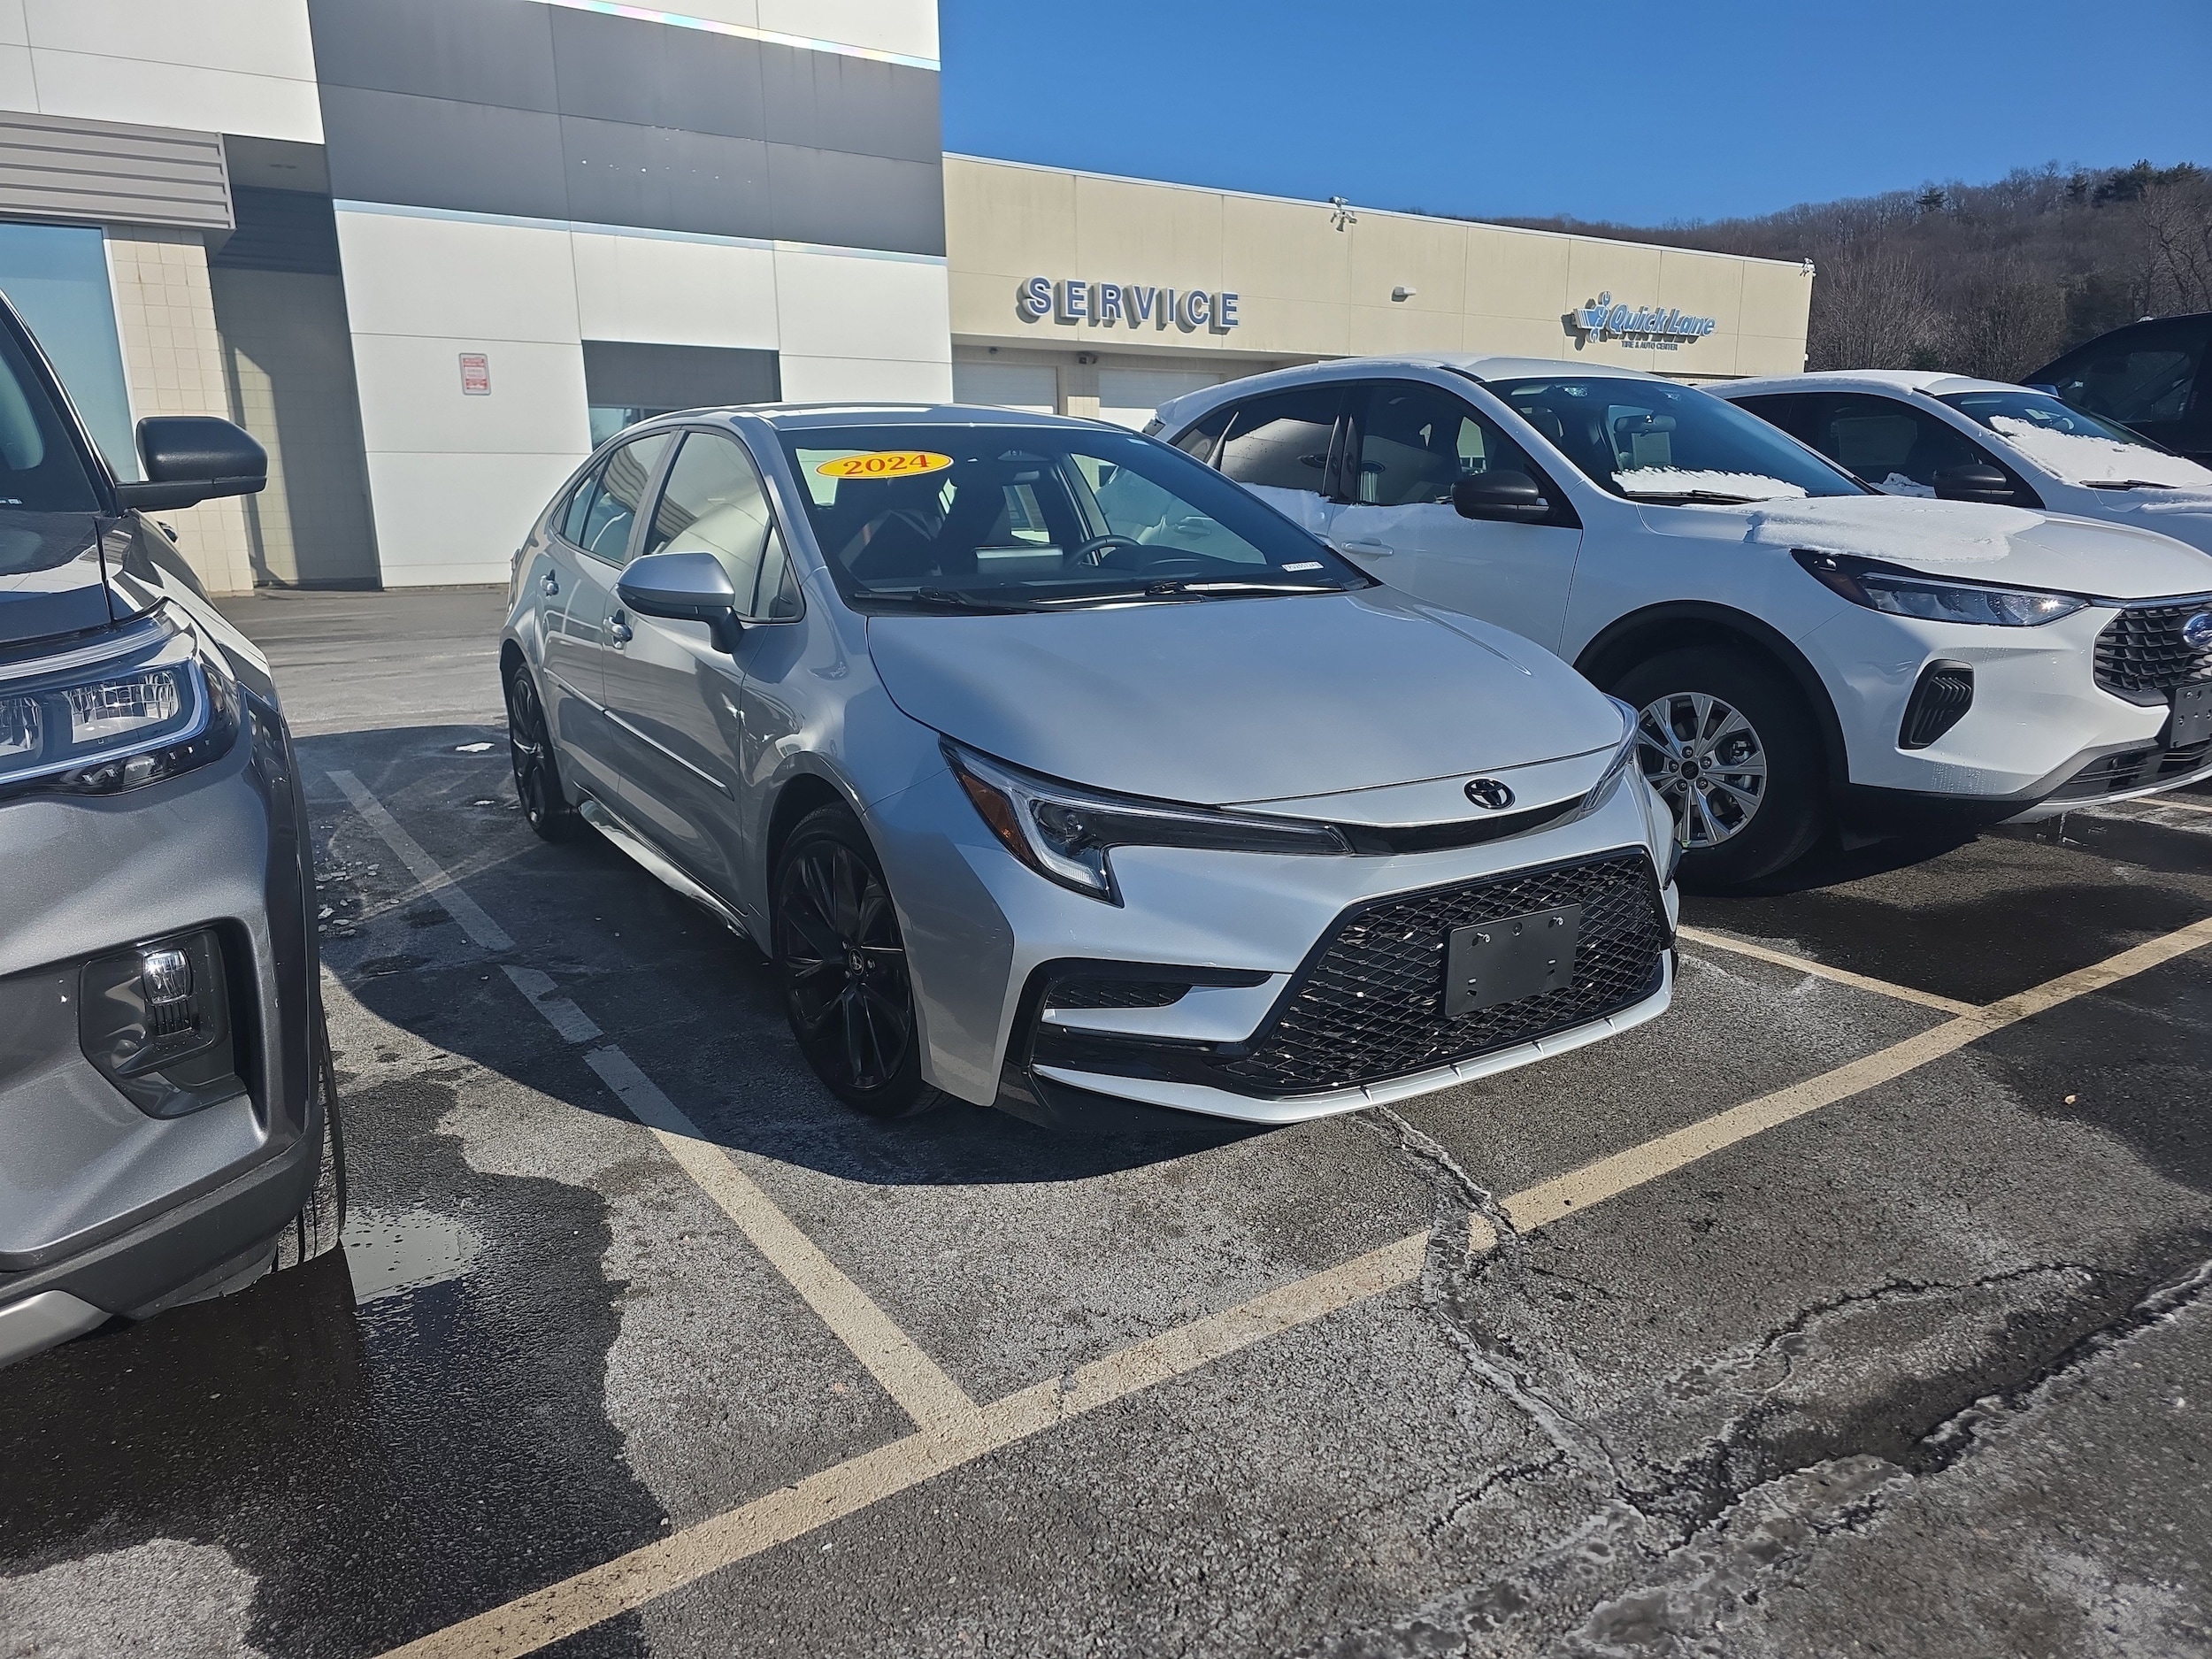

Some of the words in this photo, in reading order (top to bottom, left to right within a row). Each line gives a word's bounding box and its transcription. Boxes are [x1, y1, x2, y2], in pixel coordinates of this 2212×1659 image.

[1023, 276, 1240, 328] SERVICE
[1609, 303, 1670, 335] Quick
[1667, 308, 1717, 337] Lane
[1655, 342, 1678, 351] CENTER
[843, 454, 931, 475] 2024
